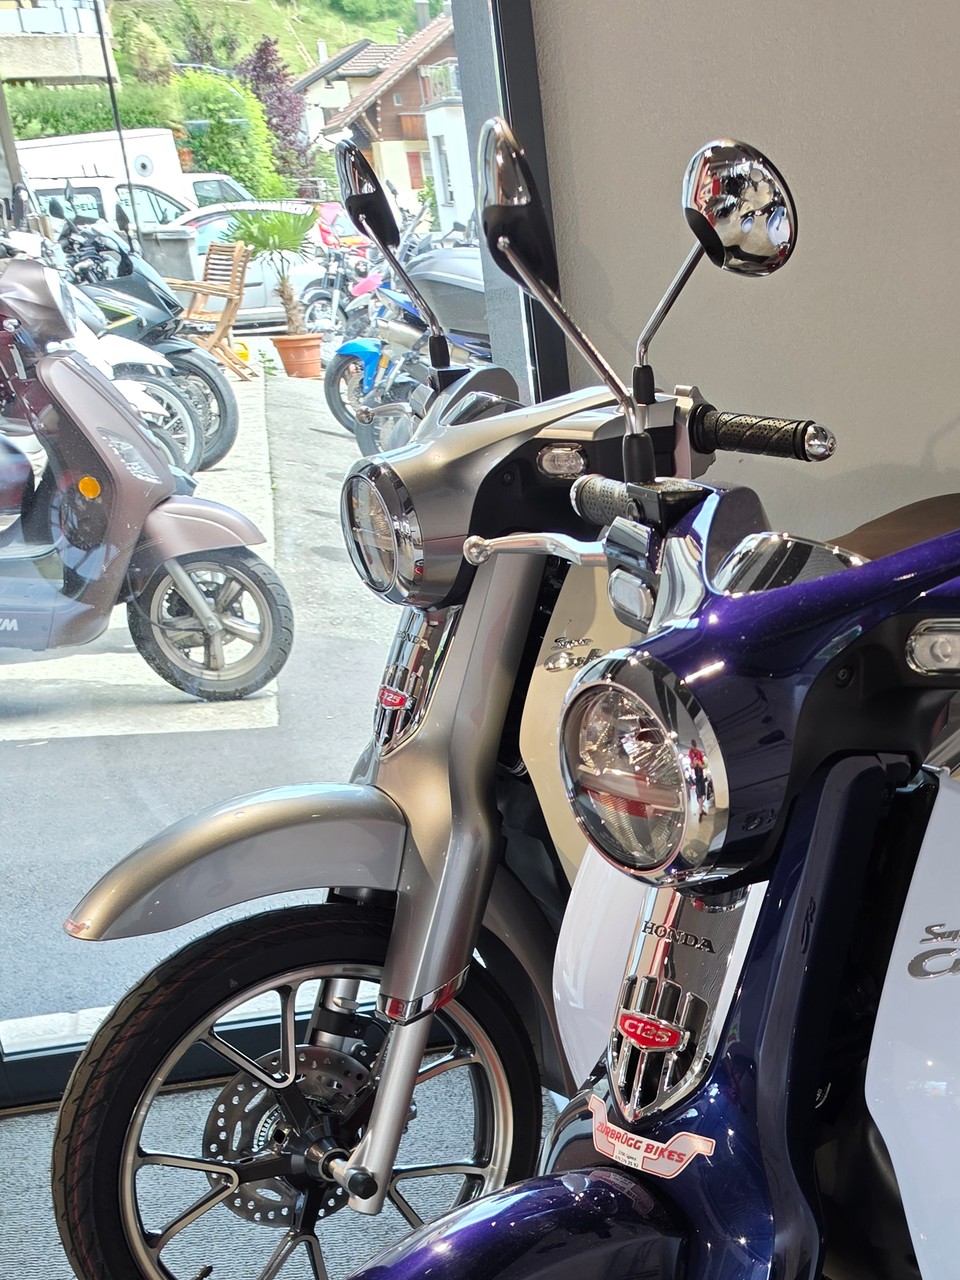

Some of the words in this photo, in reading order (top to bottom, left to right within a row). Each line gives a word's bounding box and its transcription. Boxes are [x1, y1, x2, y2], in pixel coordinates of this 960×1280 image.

[641, 919, 717, 955] HONDA
[623, 1018, 672, 1043] C125
[643, 1142, 687, 1164] BIKES
